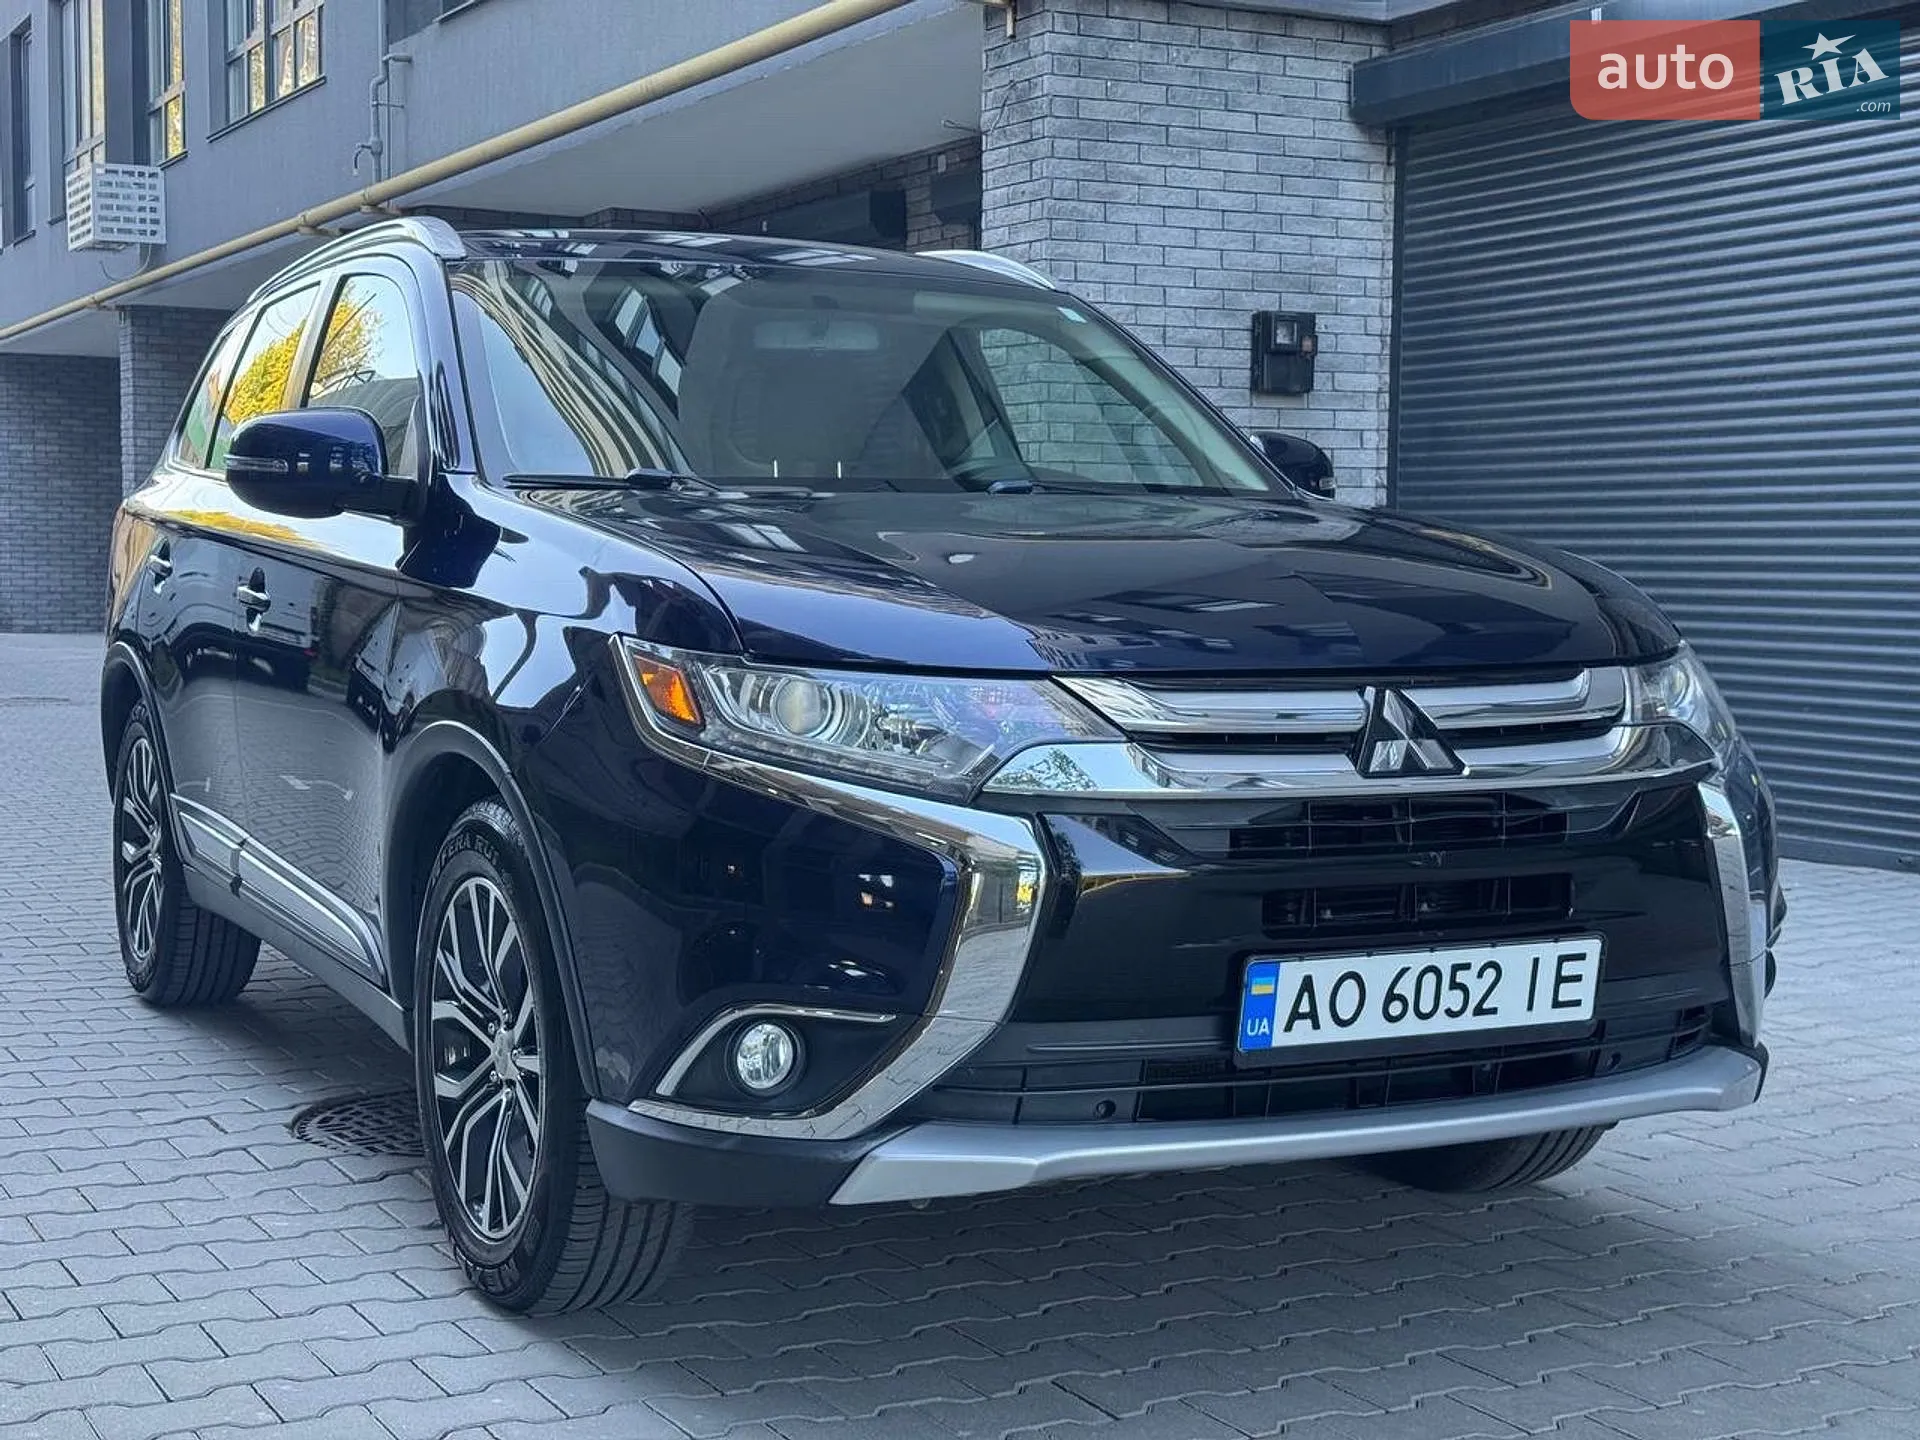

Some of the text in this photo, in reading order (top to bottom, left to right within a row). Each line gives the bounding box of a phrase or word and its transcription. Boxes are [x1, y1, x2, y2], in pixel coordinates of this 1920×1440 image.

[1283, 952, 1588, 1033] AO 6052 IE
[1246, 1017, 1271, 1037] UA
